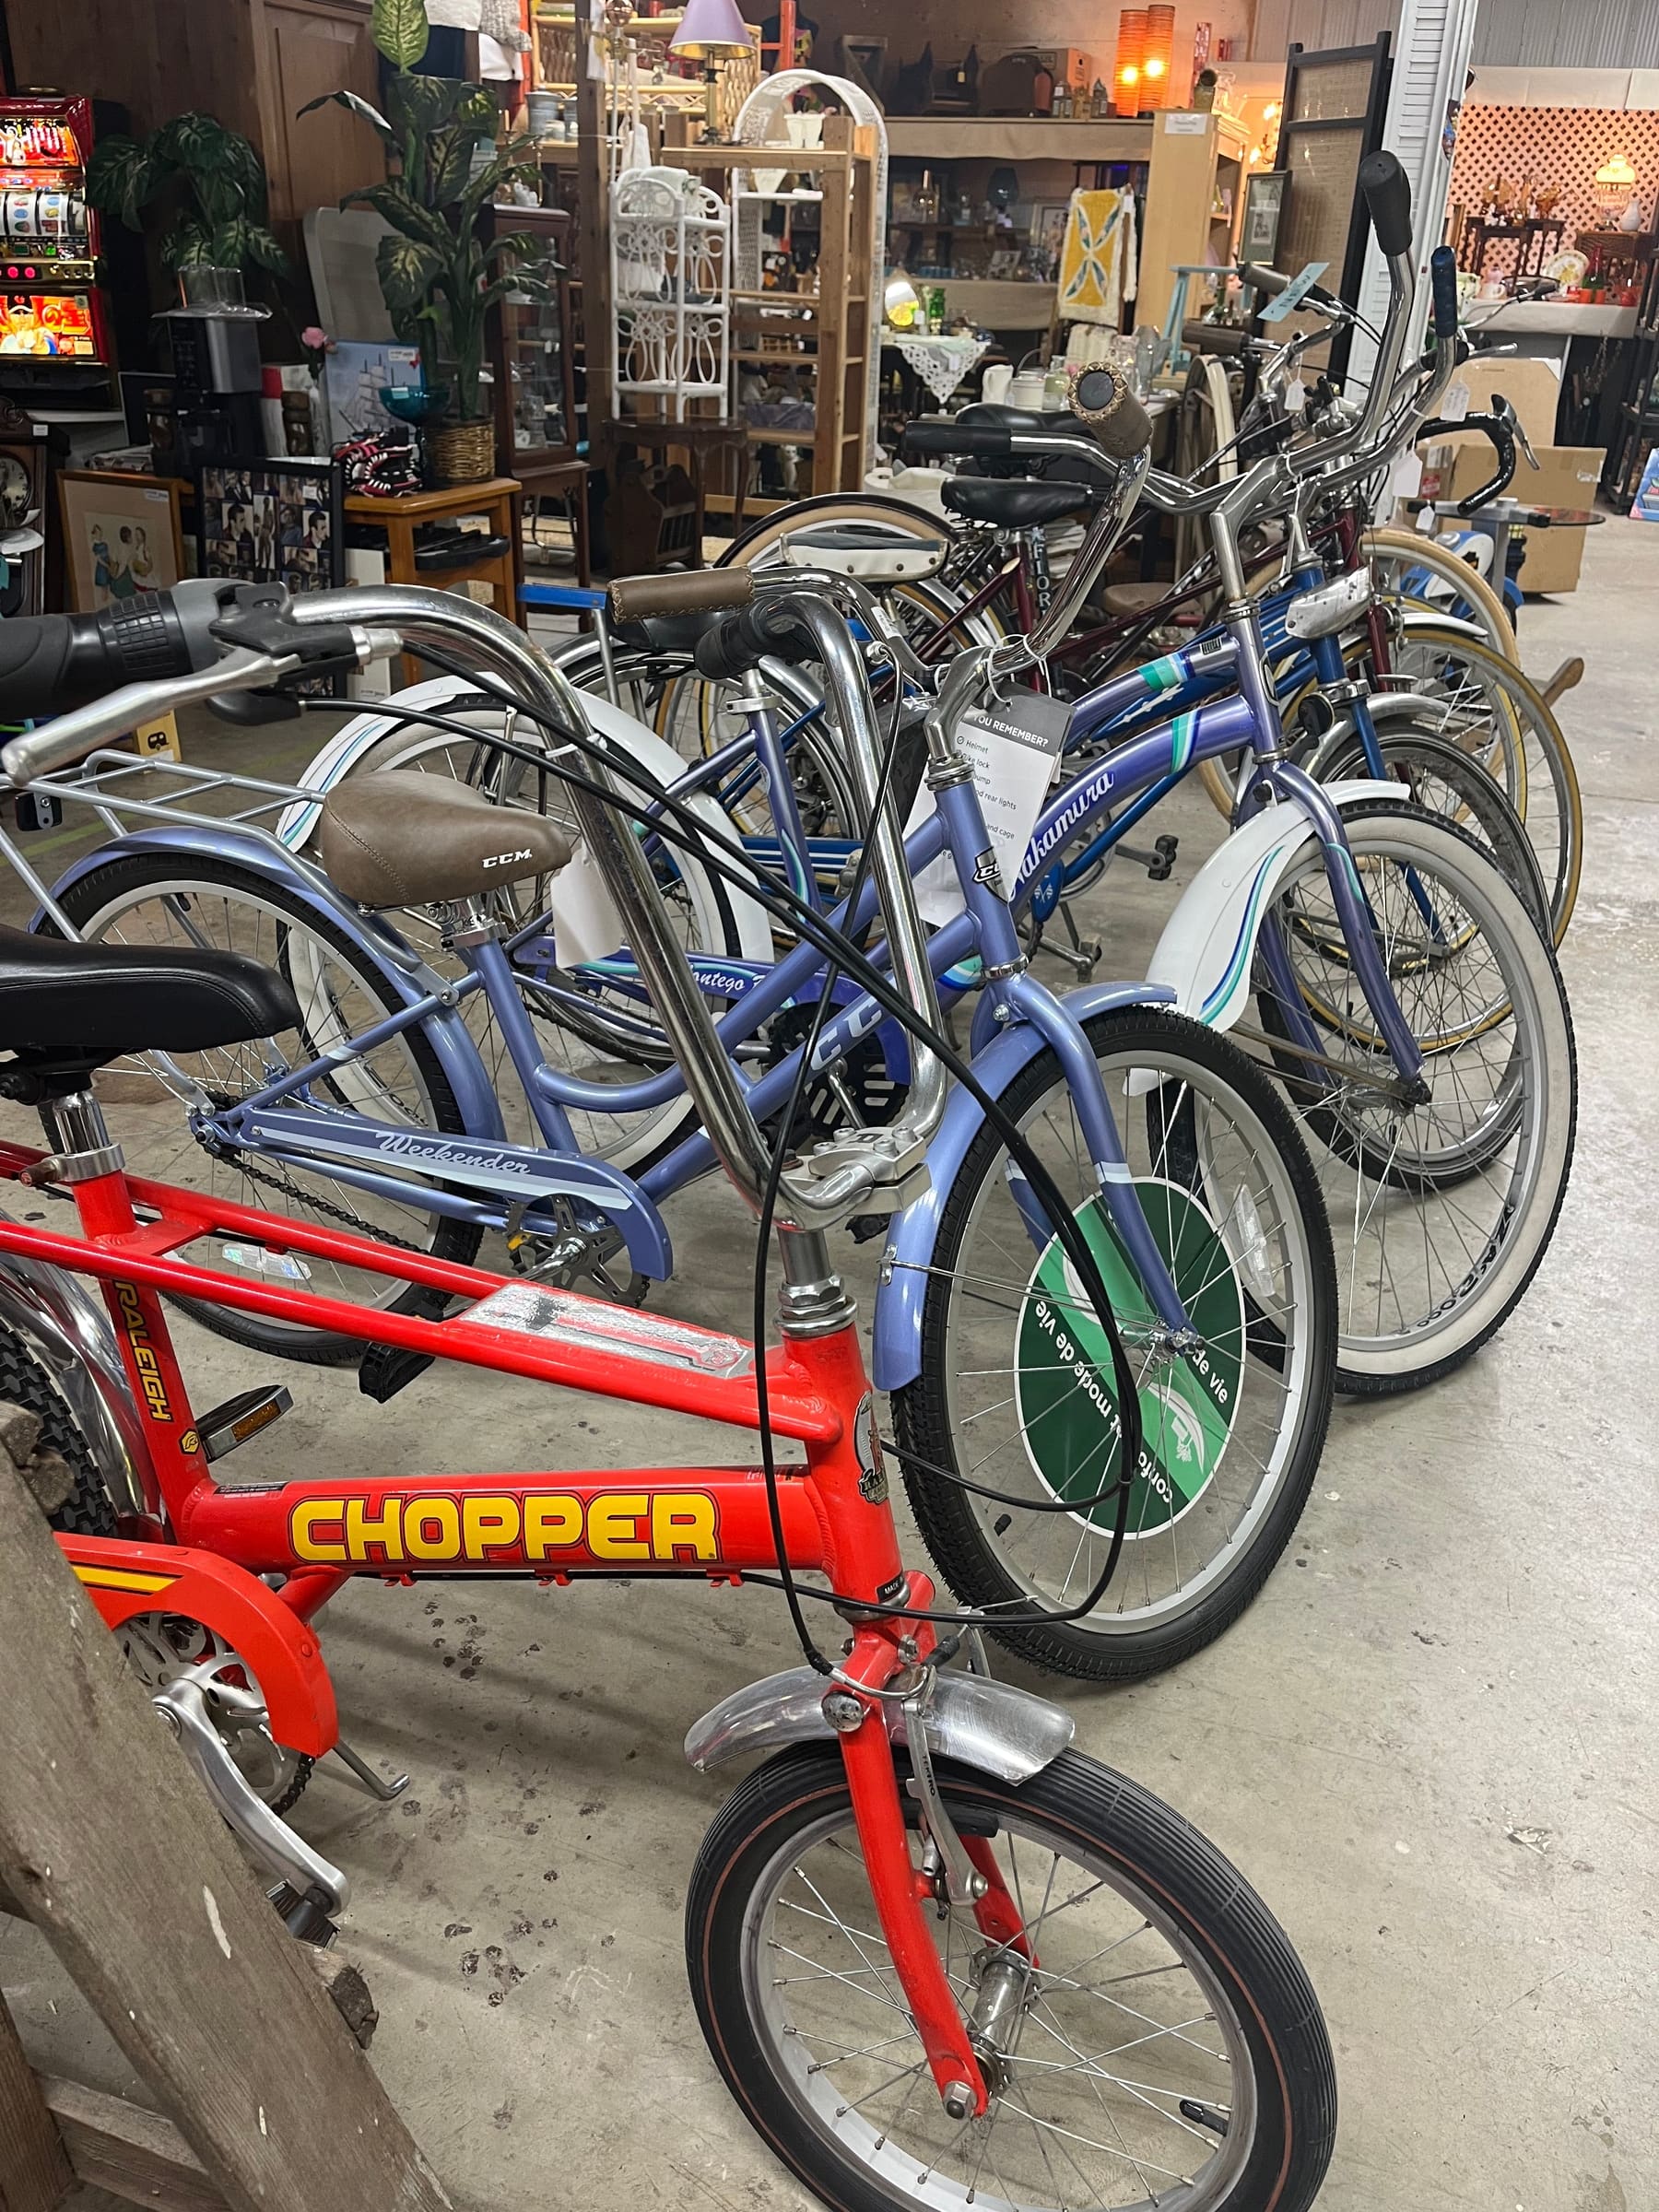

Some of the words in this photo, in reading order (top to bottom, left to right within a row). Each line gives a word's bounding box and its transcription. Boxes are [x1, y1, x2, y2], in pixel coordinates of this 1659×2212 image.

[966, 739, 988, 754] Helmet
[993, 720, 1049, 747] REMEMBER?
[977, 757, 990, 769] lock
[984, 794, 998, 803] rear
[999, 795, 1017, 811] lights
[999, 829, 1015, 840] cage
[482, 848, 532, 868] CCM
[691, 968, 745, 993] ontego
[811, 986, 889, 1070] CC
[375, 1131, 531, 1174] Weekender
[1035, 1300, 1057, 1335] vie
[113, 1280, 173, 1422] RALEIGH
[1055, 1332, 1076, 1361] de
[1074, 1359, 1112, 1418] mode
[1209, 1372, 1229, 1404] vie
[1137, 1452, 1173, 1503] confo
[290, 1492, 720, 1562] CHOPPER
